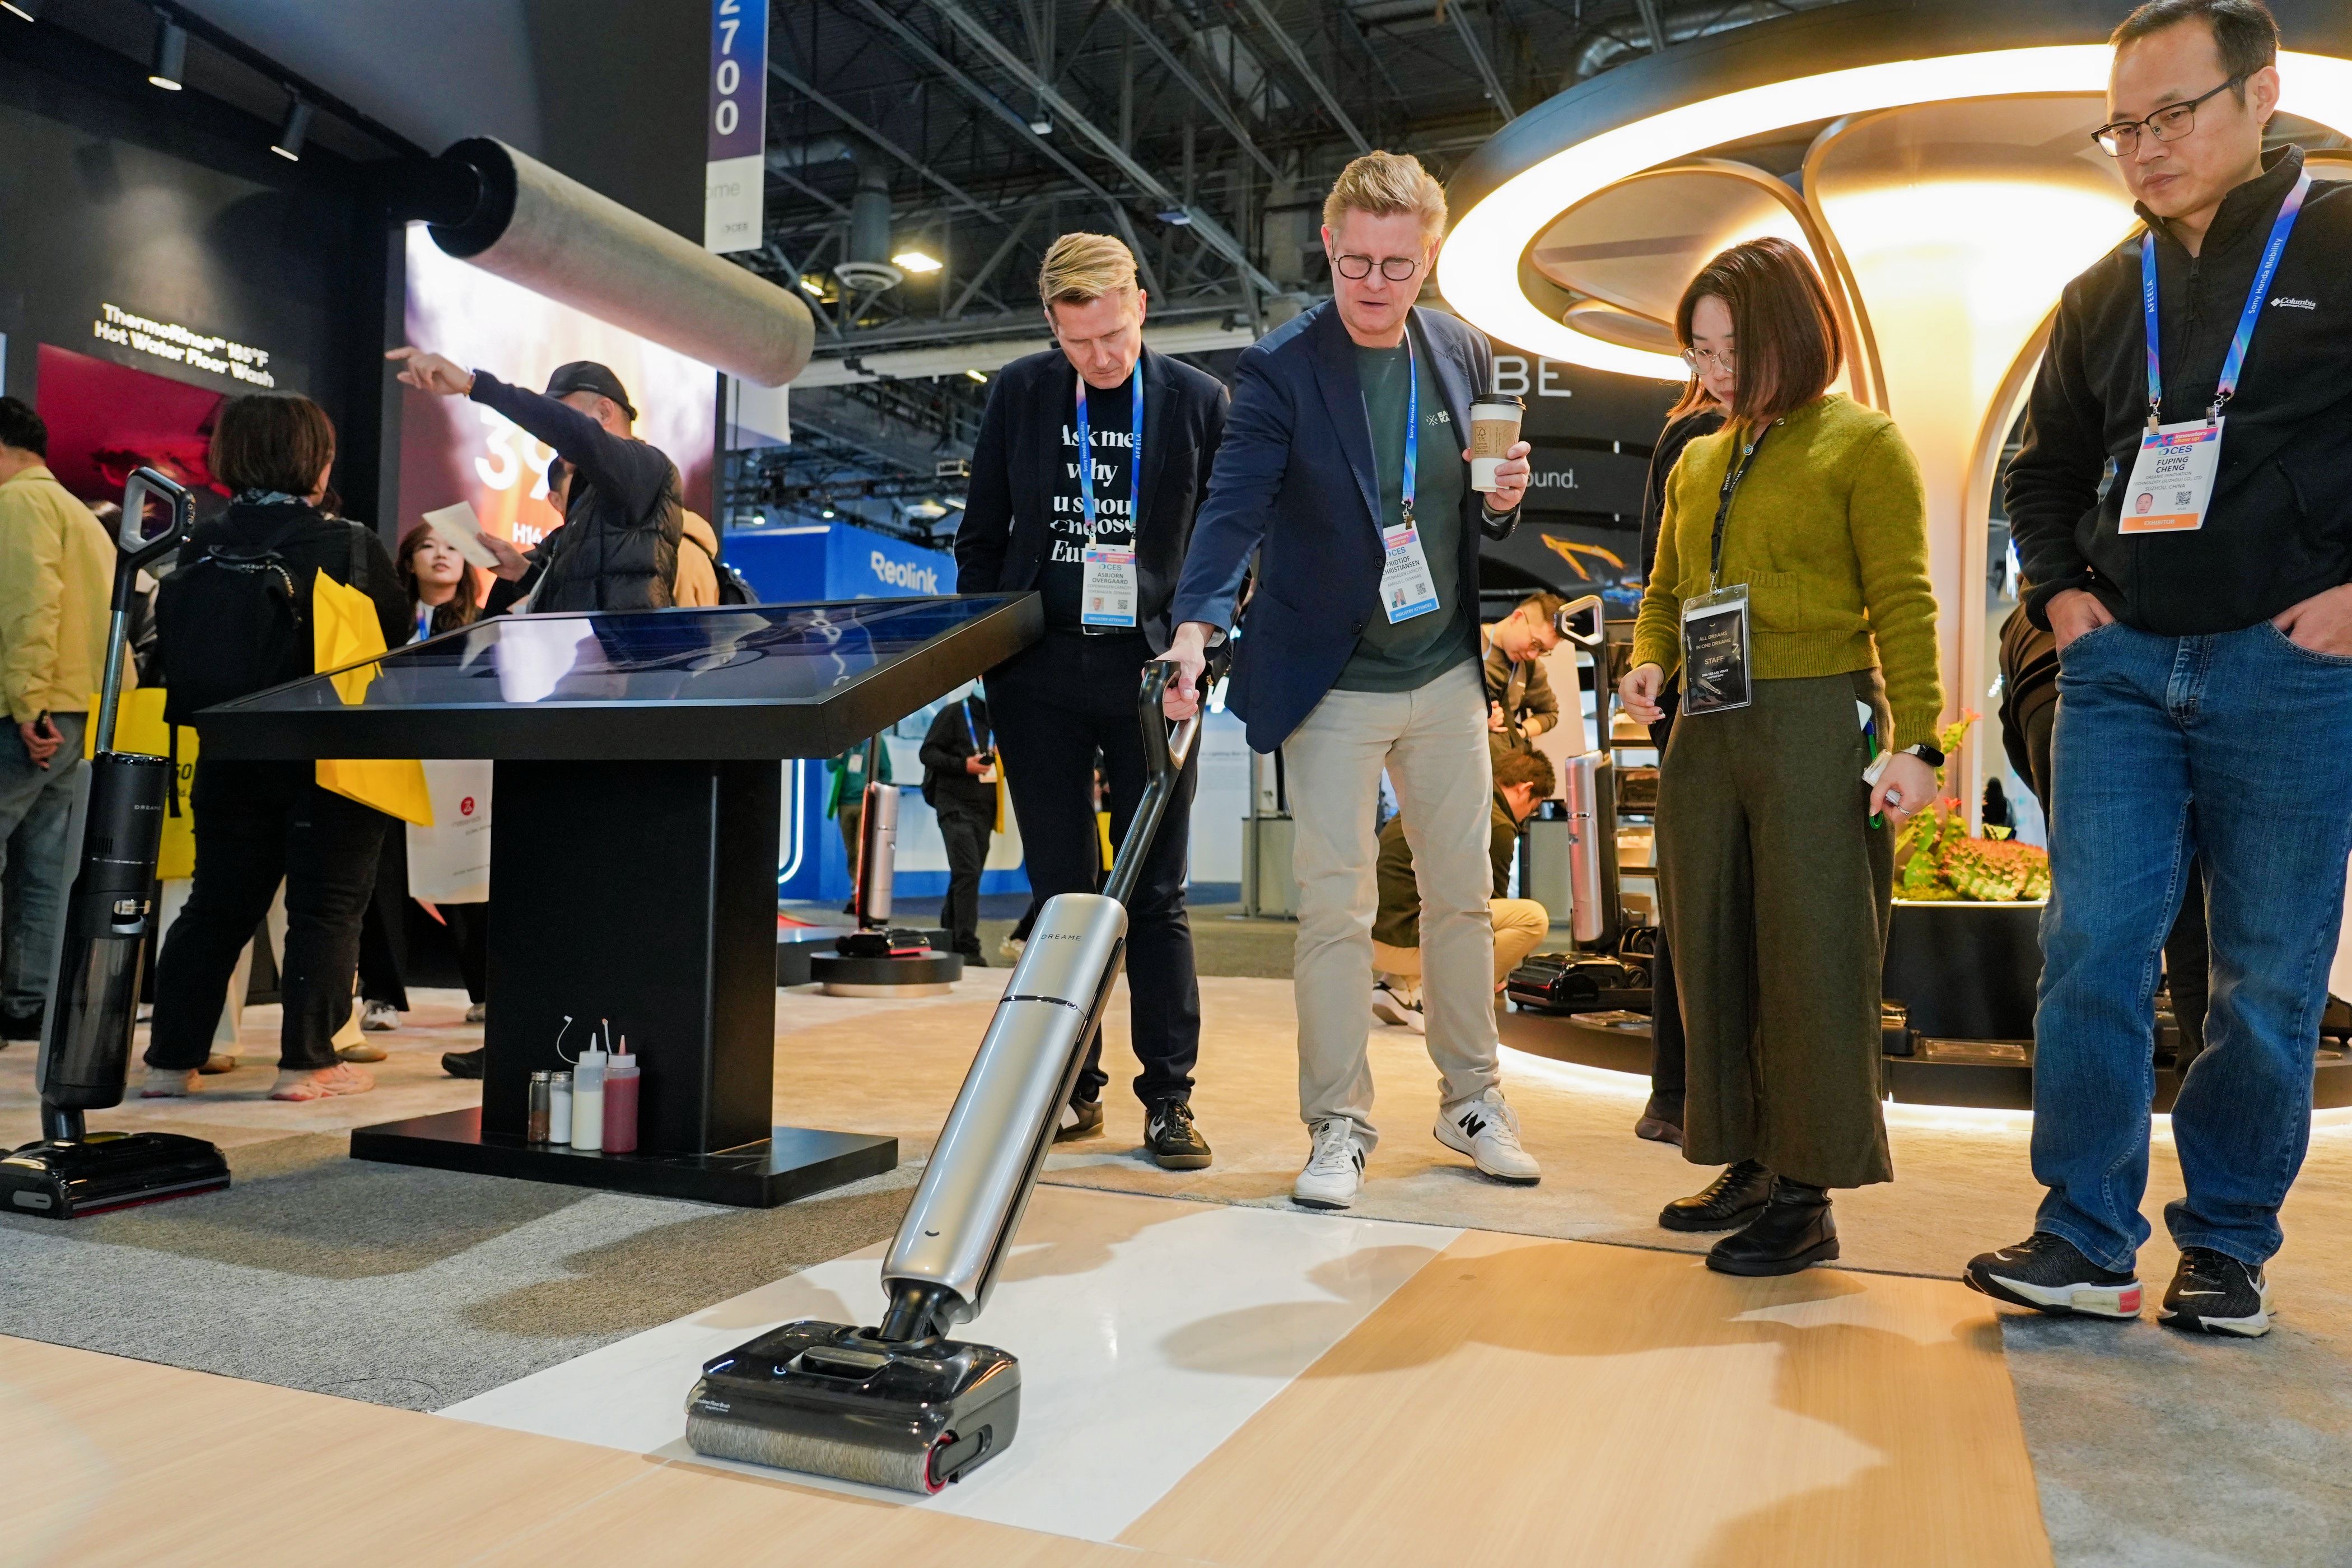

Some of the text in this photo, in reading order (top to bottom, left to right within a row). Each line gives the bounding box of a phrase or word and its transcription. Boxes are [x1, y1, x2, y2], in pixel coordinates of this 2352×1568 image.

[2248, 237, 2283, 314] Sony Honda Mobility
[2280, 297, 2316, 307] Columbia
[94, 320, 274, 388] Hot Water Floor Wash
[1100, 431, 1133, 448] me
[2175, 431, 2208, 439] innovators
[2171, 445, 2192, 455] CES
[2157, 456, 2189, 466] FUPING
[1066, 458, 1119, 487] why
[2156, 464, 2185, 473] CHENG
[1392, 547, 1406, 556] CES
[1386, 556, 1410, 568] FRIDTJOF
[871, 550, 939, 595] Reolink
[1395, 603, 1432, 618] INDUSTRY ATTENDEE
[1708, 631, 1728, 640] DREAMS
[1711, 638, 1732, 646] DREAME
[1705, 655, 1724, 665] STAFF
